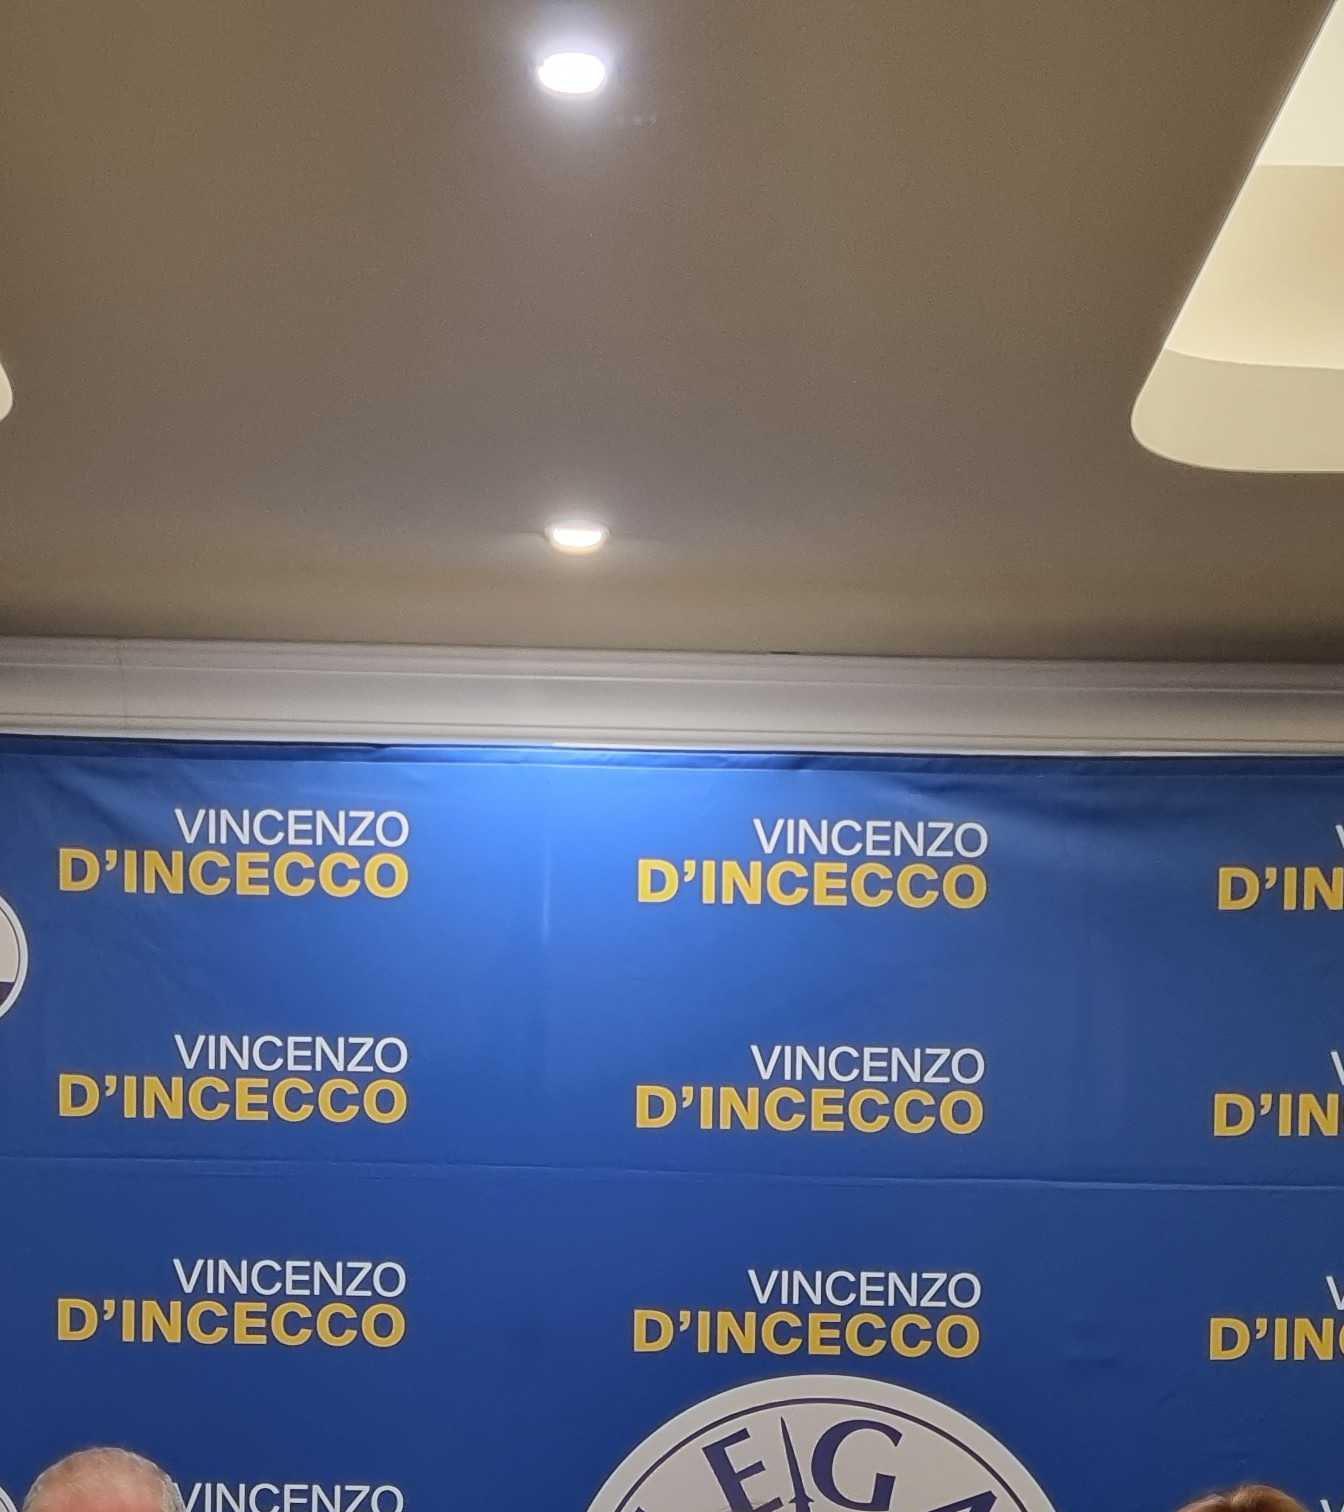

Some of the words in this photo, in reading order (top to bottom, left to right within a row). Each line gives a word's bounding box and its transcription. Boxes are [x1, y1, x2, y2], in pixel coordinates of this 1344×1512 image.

[174, 809, 410, 847] VINCENZO
[753, 818, 989, 859] VINCENZO
[58, 848, 408, 897] D'INCECCO
[638, 860, 988, 909] D'INCECCO
[174, 1034, 409, 1073] VINCENZO
[751, 1045, 985, 1084] VINCENZO
[58, 1074, 407, 1124] D'INCECCO
[635, 1085, 984, 1133] D'INCECCO
[172, 1259, 406, 1297] VINCENZO
[748, 1270, 982, 1309] VINCENZO
[57, 1298, 406, 1347] D'INCECCO
[632, 1310, 981, 1358] D'INCECCO
